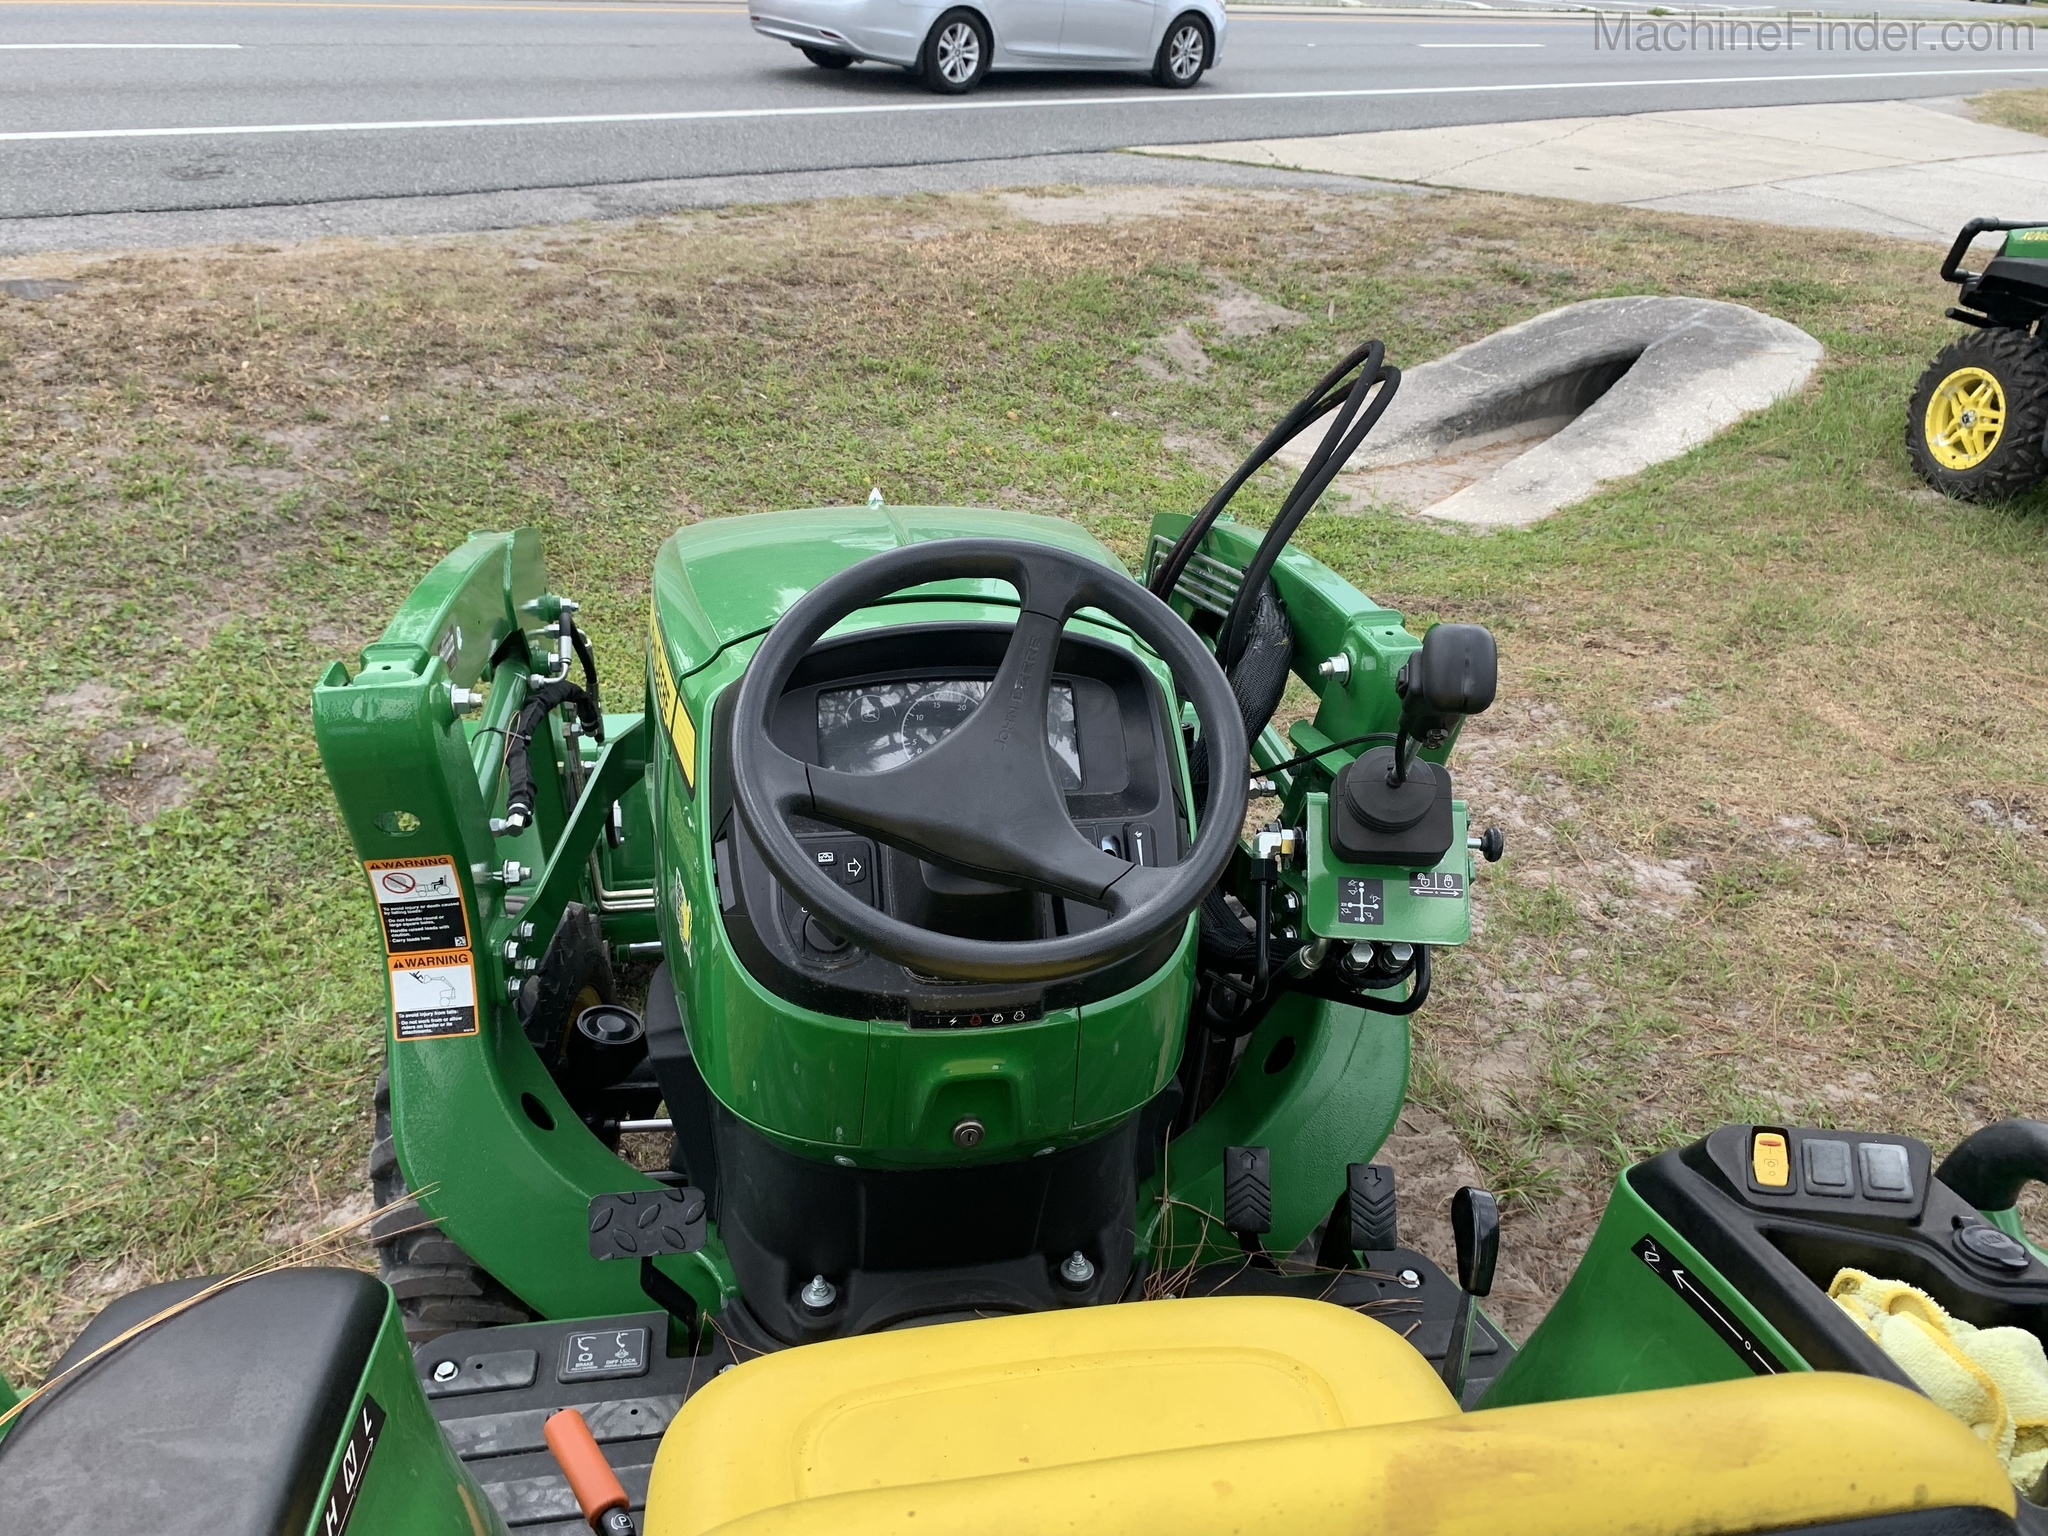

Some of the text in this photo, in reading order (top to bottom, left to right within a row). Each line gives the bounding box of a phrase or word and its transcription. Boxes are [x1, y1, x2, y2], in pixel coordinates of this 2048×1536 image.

[994, 635, 1041, 751] JOHN DEERE
[381, 858, 448, 869] WARNING
[405, 954, 468, 968] WARNING
